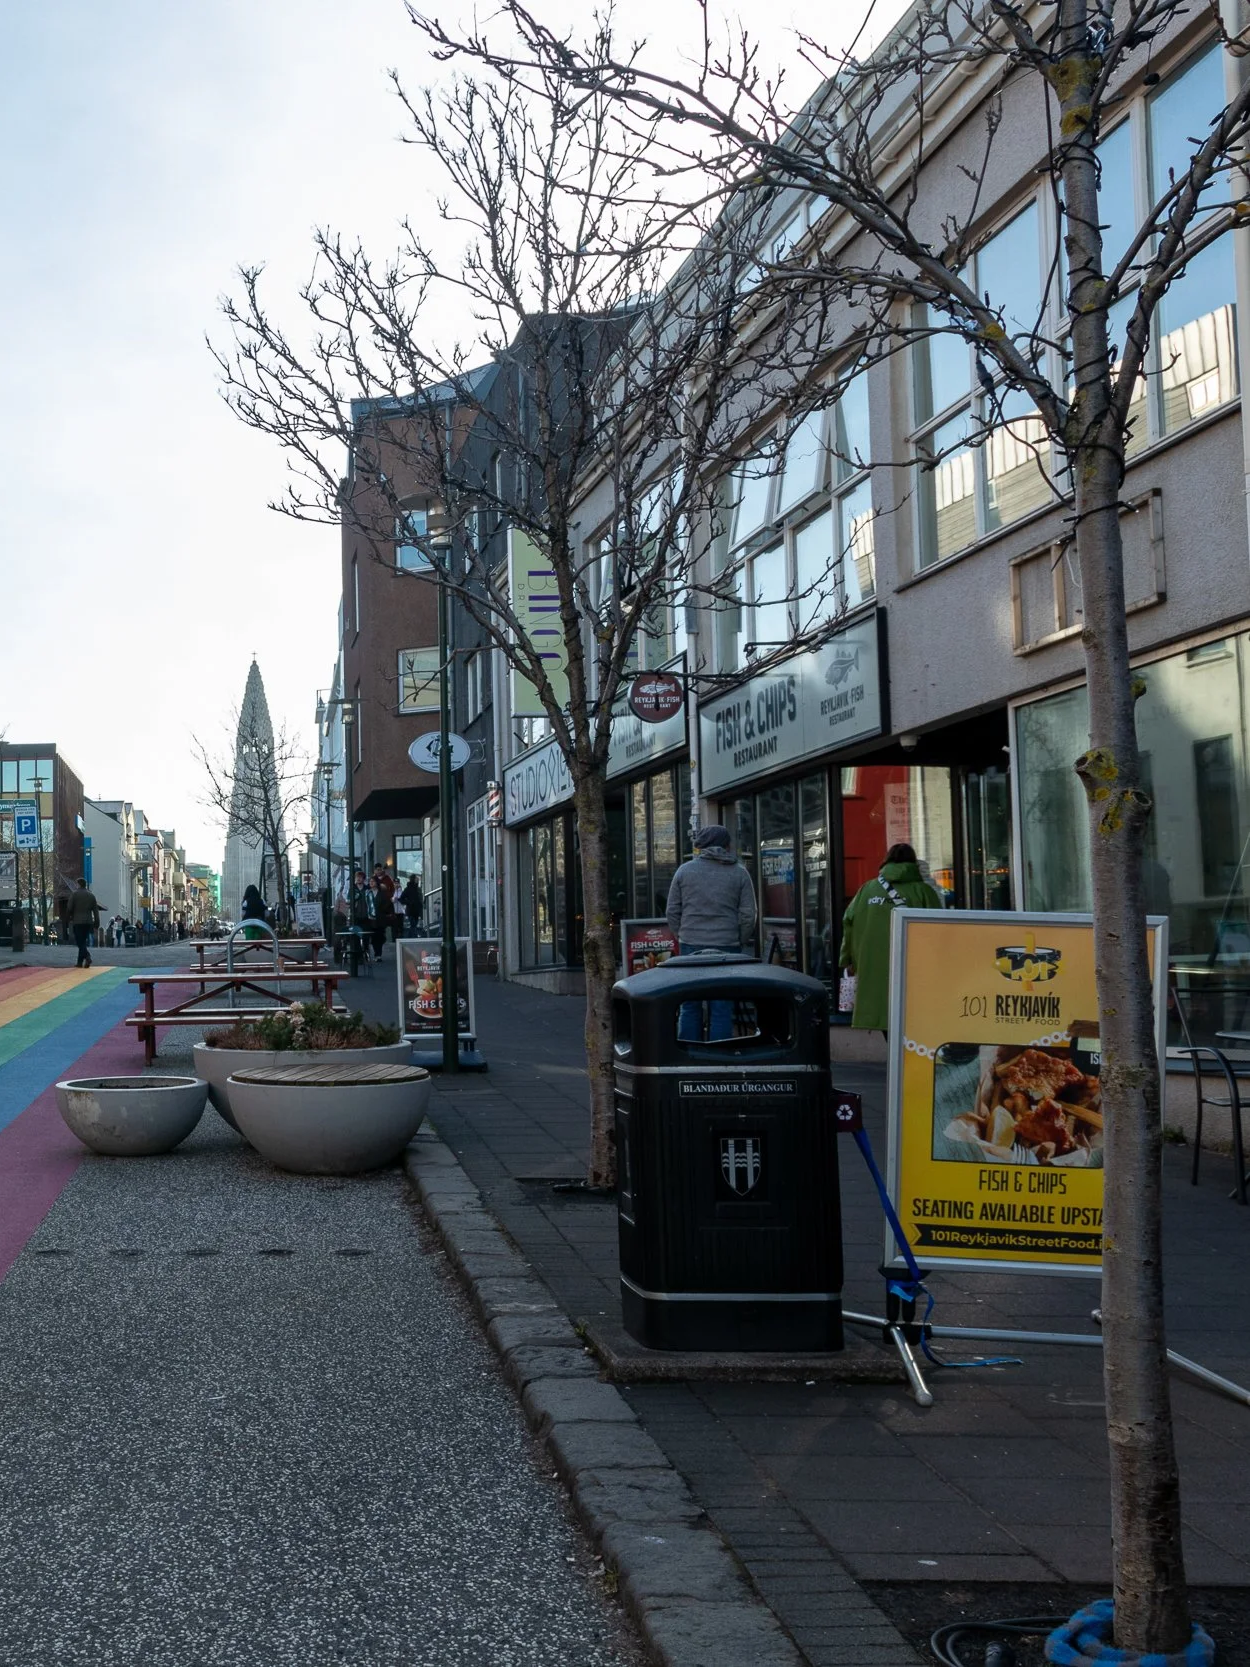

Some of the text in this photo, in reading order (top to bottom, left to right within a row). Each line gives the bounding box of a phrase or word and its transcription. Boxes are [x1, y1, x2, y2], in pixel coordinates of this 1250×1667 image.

[634, 696, 665, 704] REYKJAIK
[715, 675, 798, 754] FISH & CHIPS
[829, 706, 856, 727] RESTAURANT
[734, 736, 778, 770] RESTAURANT
[22, 819, 31, 832] P
[631, 941, 648, 949] FISH
[652, 940, 675, 948] CHIPS
[408, 1000, 429, 1009] FISH
[960, 992, 1061, 1022] 101 REYKJAVÍK
[995, 1017, 1061, 1026] STREET FOOD
[741, 1081, 794, 1093] ÚRGANGUR
[979, 1169, 1068, 1195] FISH & CHIPS
[912, 1198, 1103, 1227] SEATING AVAILABLE UPSTA
[931, 1230, 1103, 1250] 101ReykjavikStreetFood.i
